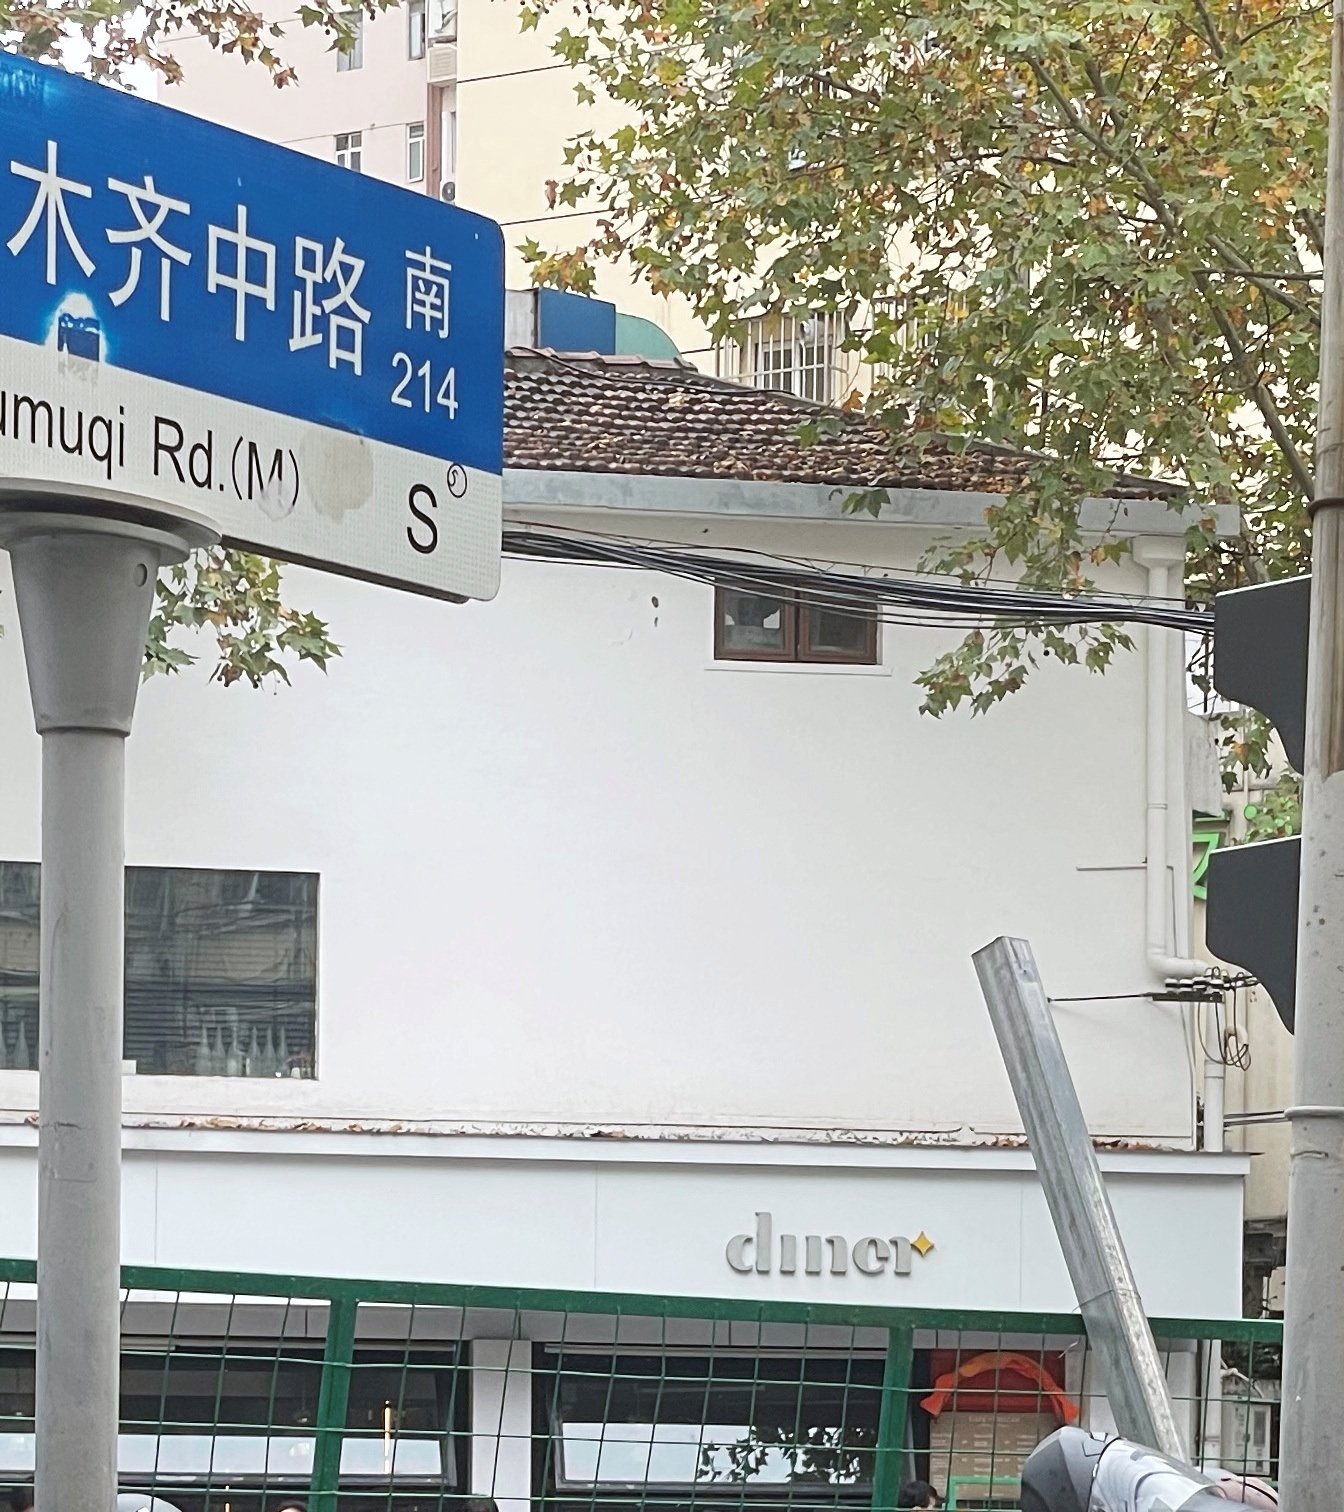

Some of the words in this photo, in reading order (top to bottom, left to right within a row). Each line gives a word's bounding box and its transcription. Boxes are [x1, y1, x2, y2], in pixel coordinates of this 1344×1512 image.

[404, 246, 453, 341] 南
[390, 351, 460, 421] 214
[406, 483, 440, 555] S
[726, 1212, 912, 1275] diner
